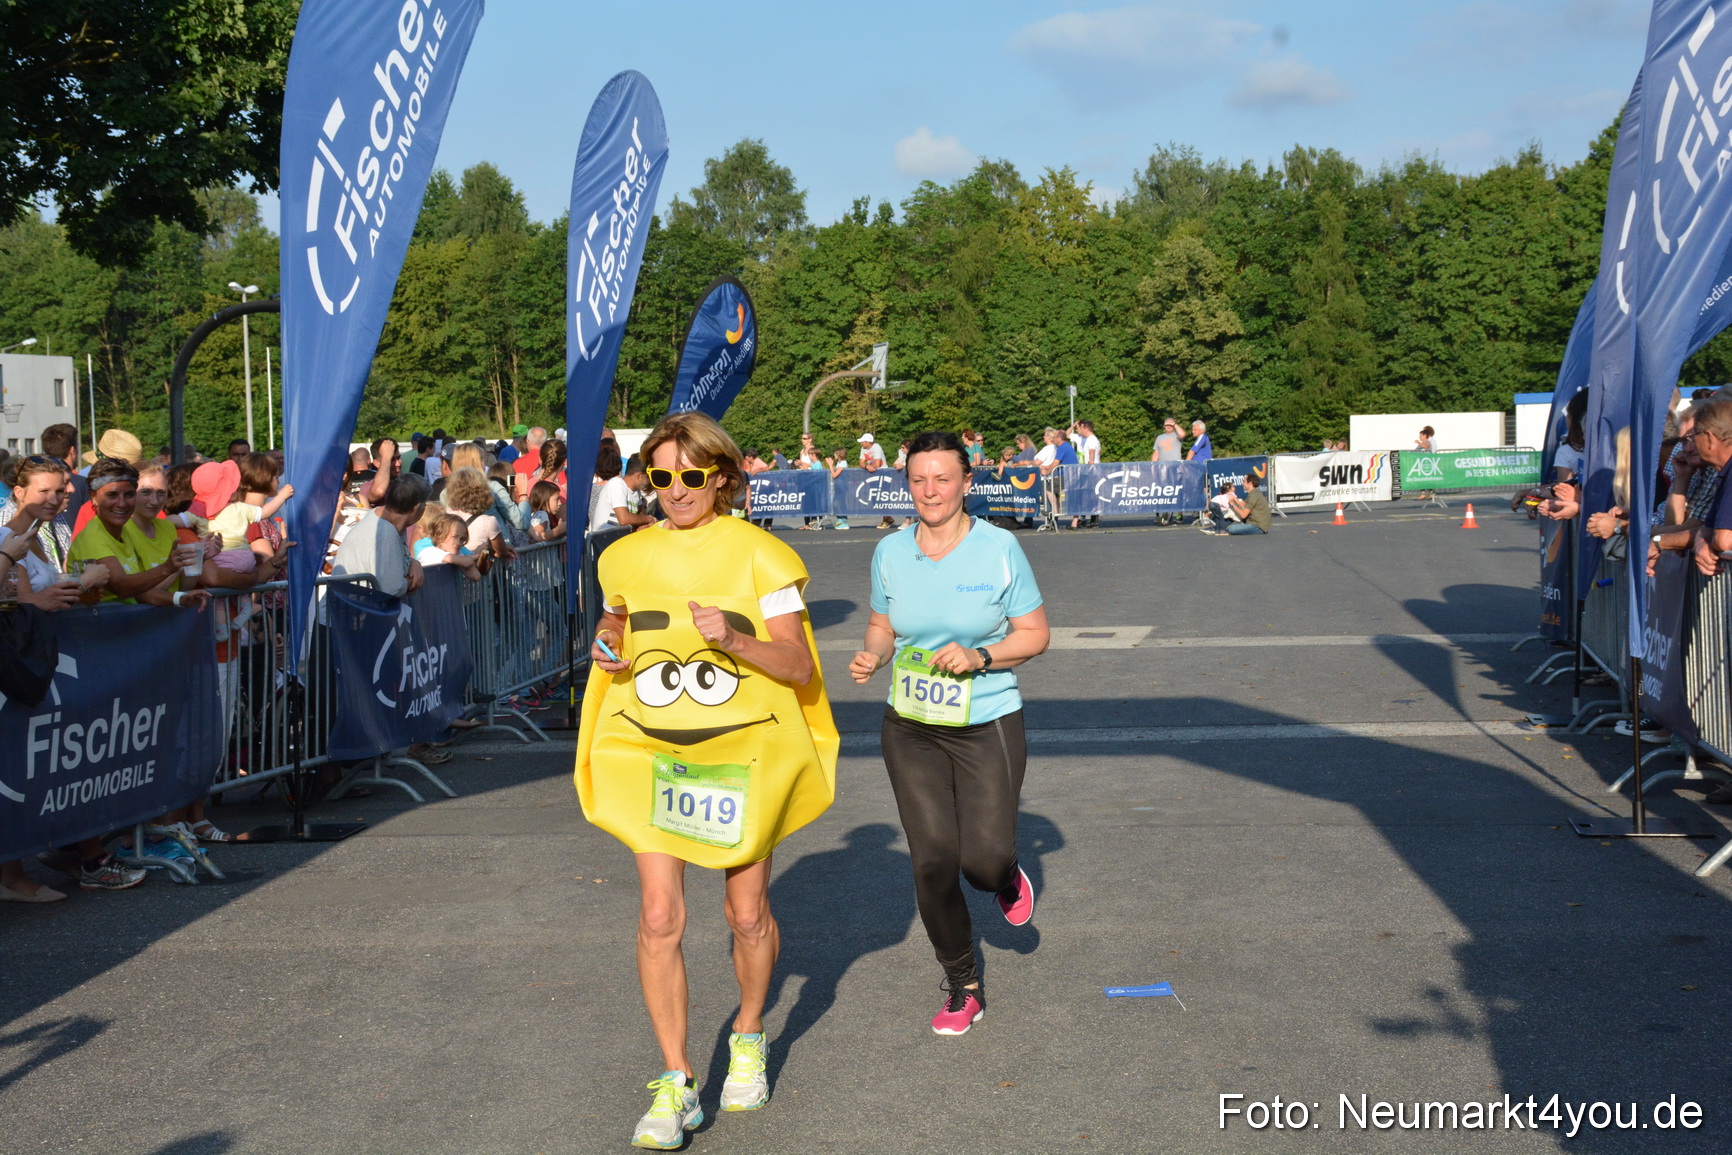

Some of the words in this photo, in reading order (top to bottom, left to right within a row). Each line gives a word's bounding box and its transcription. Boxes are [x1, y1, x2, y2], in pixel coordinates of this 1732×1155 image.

[334, 0, 432, 265] Fische
[368, 9, 448, 259] AUTOMOBILE
[588, 116, 643, 327] Fischer
[1407, 457, 1443, 476] AOK
[1454, 454, 1530, 469] GESUNDHEIT
[1213, 472, 1247, 488] Frischm
[1318, 464, 1363, 487] swn
[1111, 482, 1183, 498] Fischer
[752, 503, 801, 512] AUTOMOBILE
[873, 502, 915, 510] AUTOMOBIL
[1118, 498, 1177, 506] AUTOMOBILE
[966, 583, 994, 592] sumida
[901, 675, 962, 707] 1502
[27, 697, 167, 779] Fischer
[40, 760, 155, 816] AUTOMOBILE
[662, 787, 737, 825] 1019
